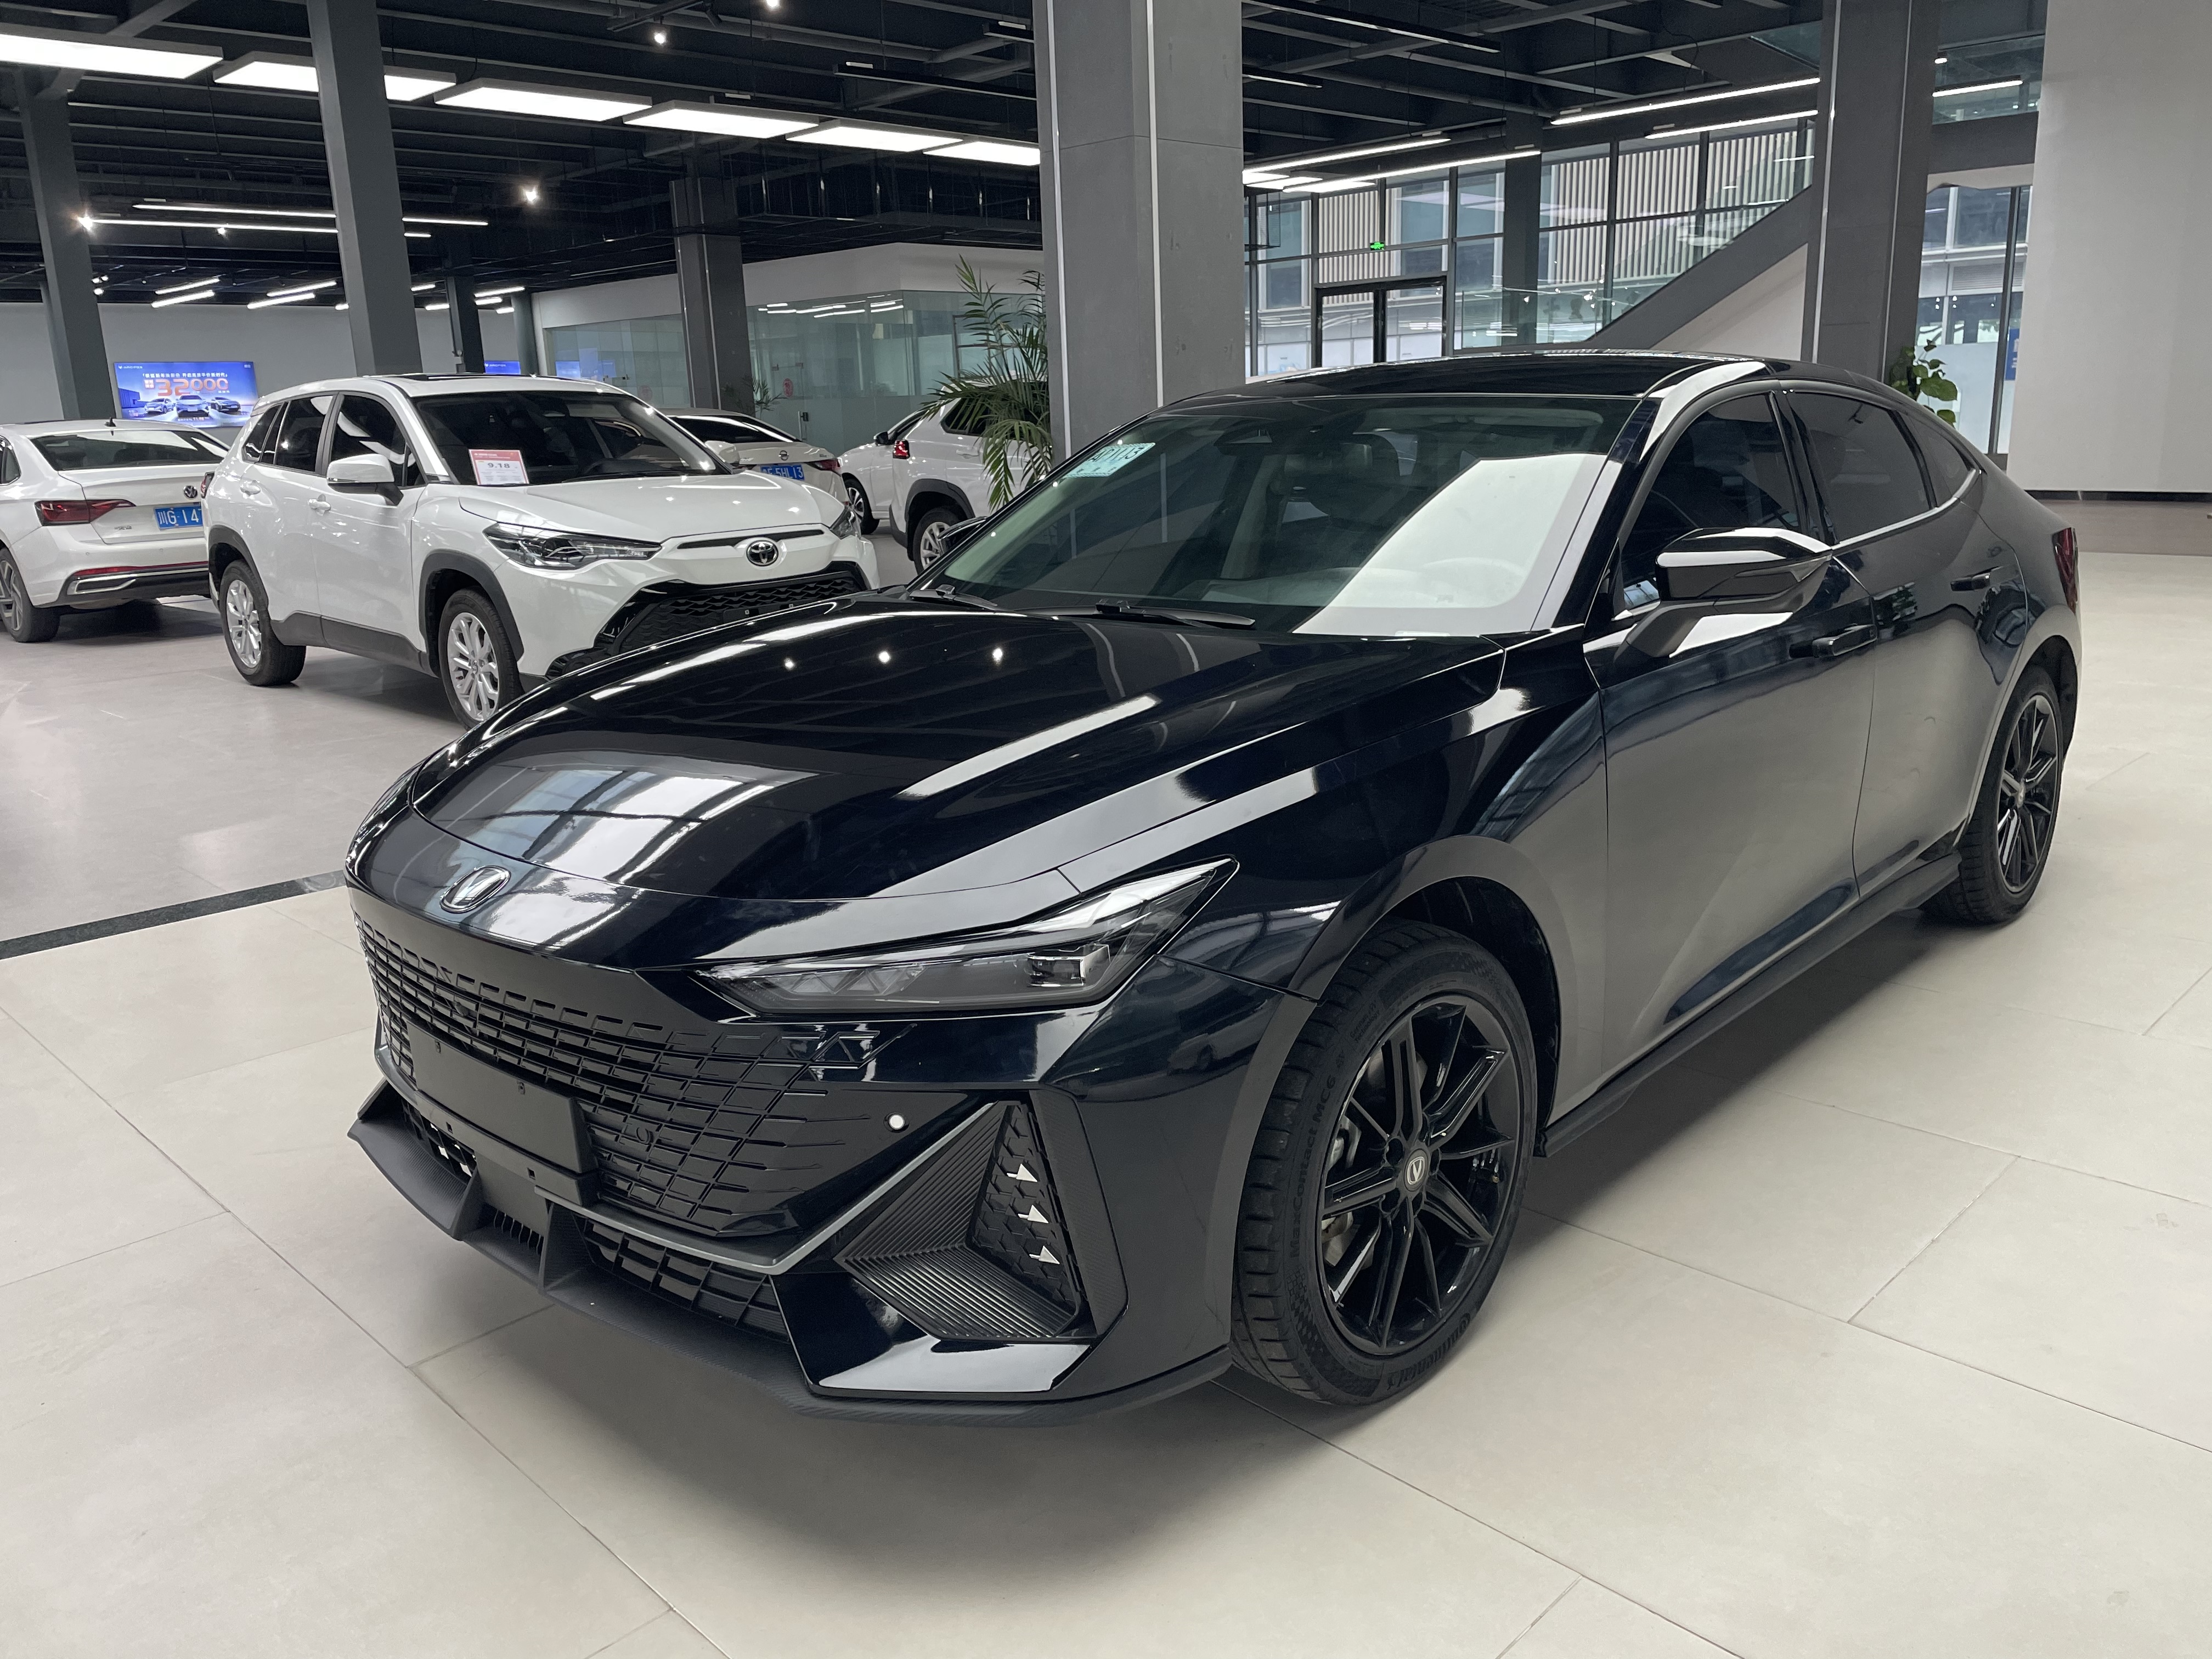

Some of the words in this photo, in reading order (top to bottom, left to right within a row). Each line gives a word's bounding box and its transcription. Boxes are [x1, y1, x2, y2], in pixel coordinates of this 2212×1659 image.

[155, 378, 229, 396] 32000
[158, 509, 201, 525] 川G·14
[1290, 1127, 1317, 1257] MaxContact
